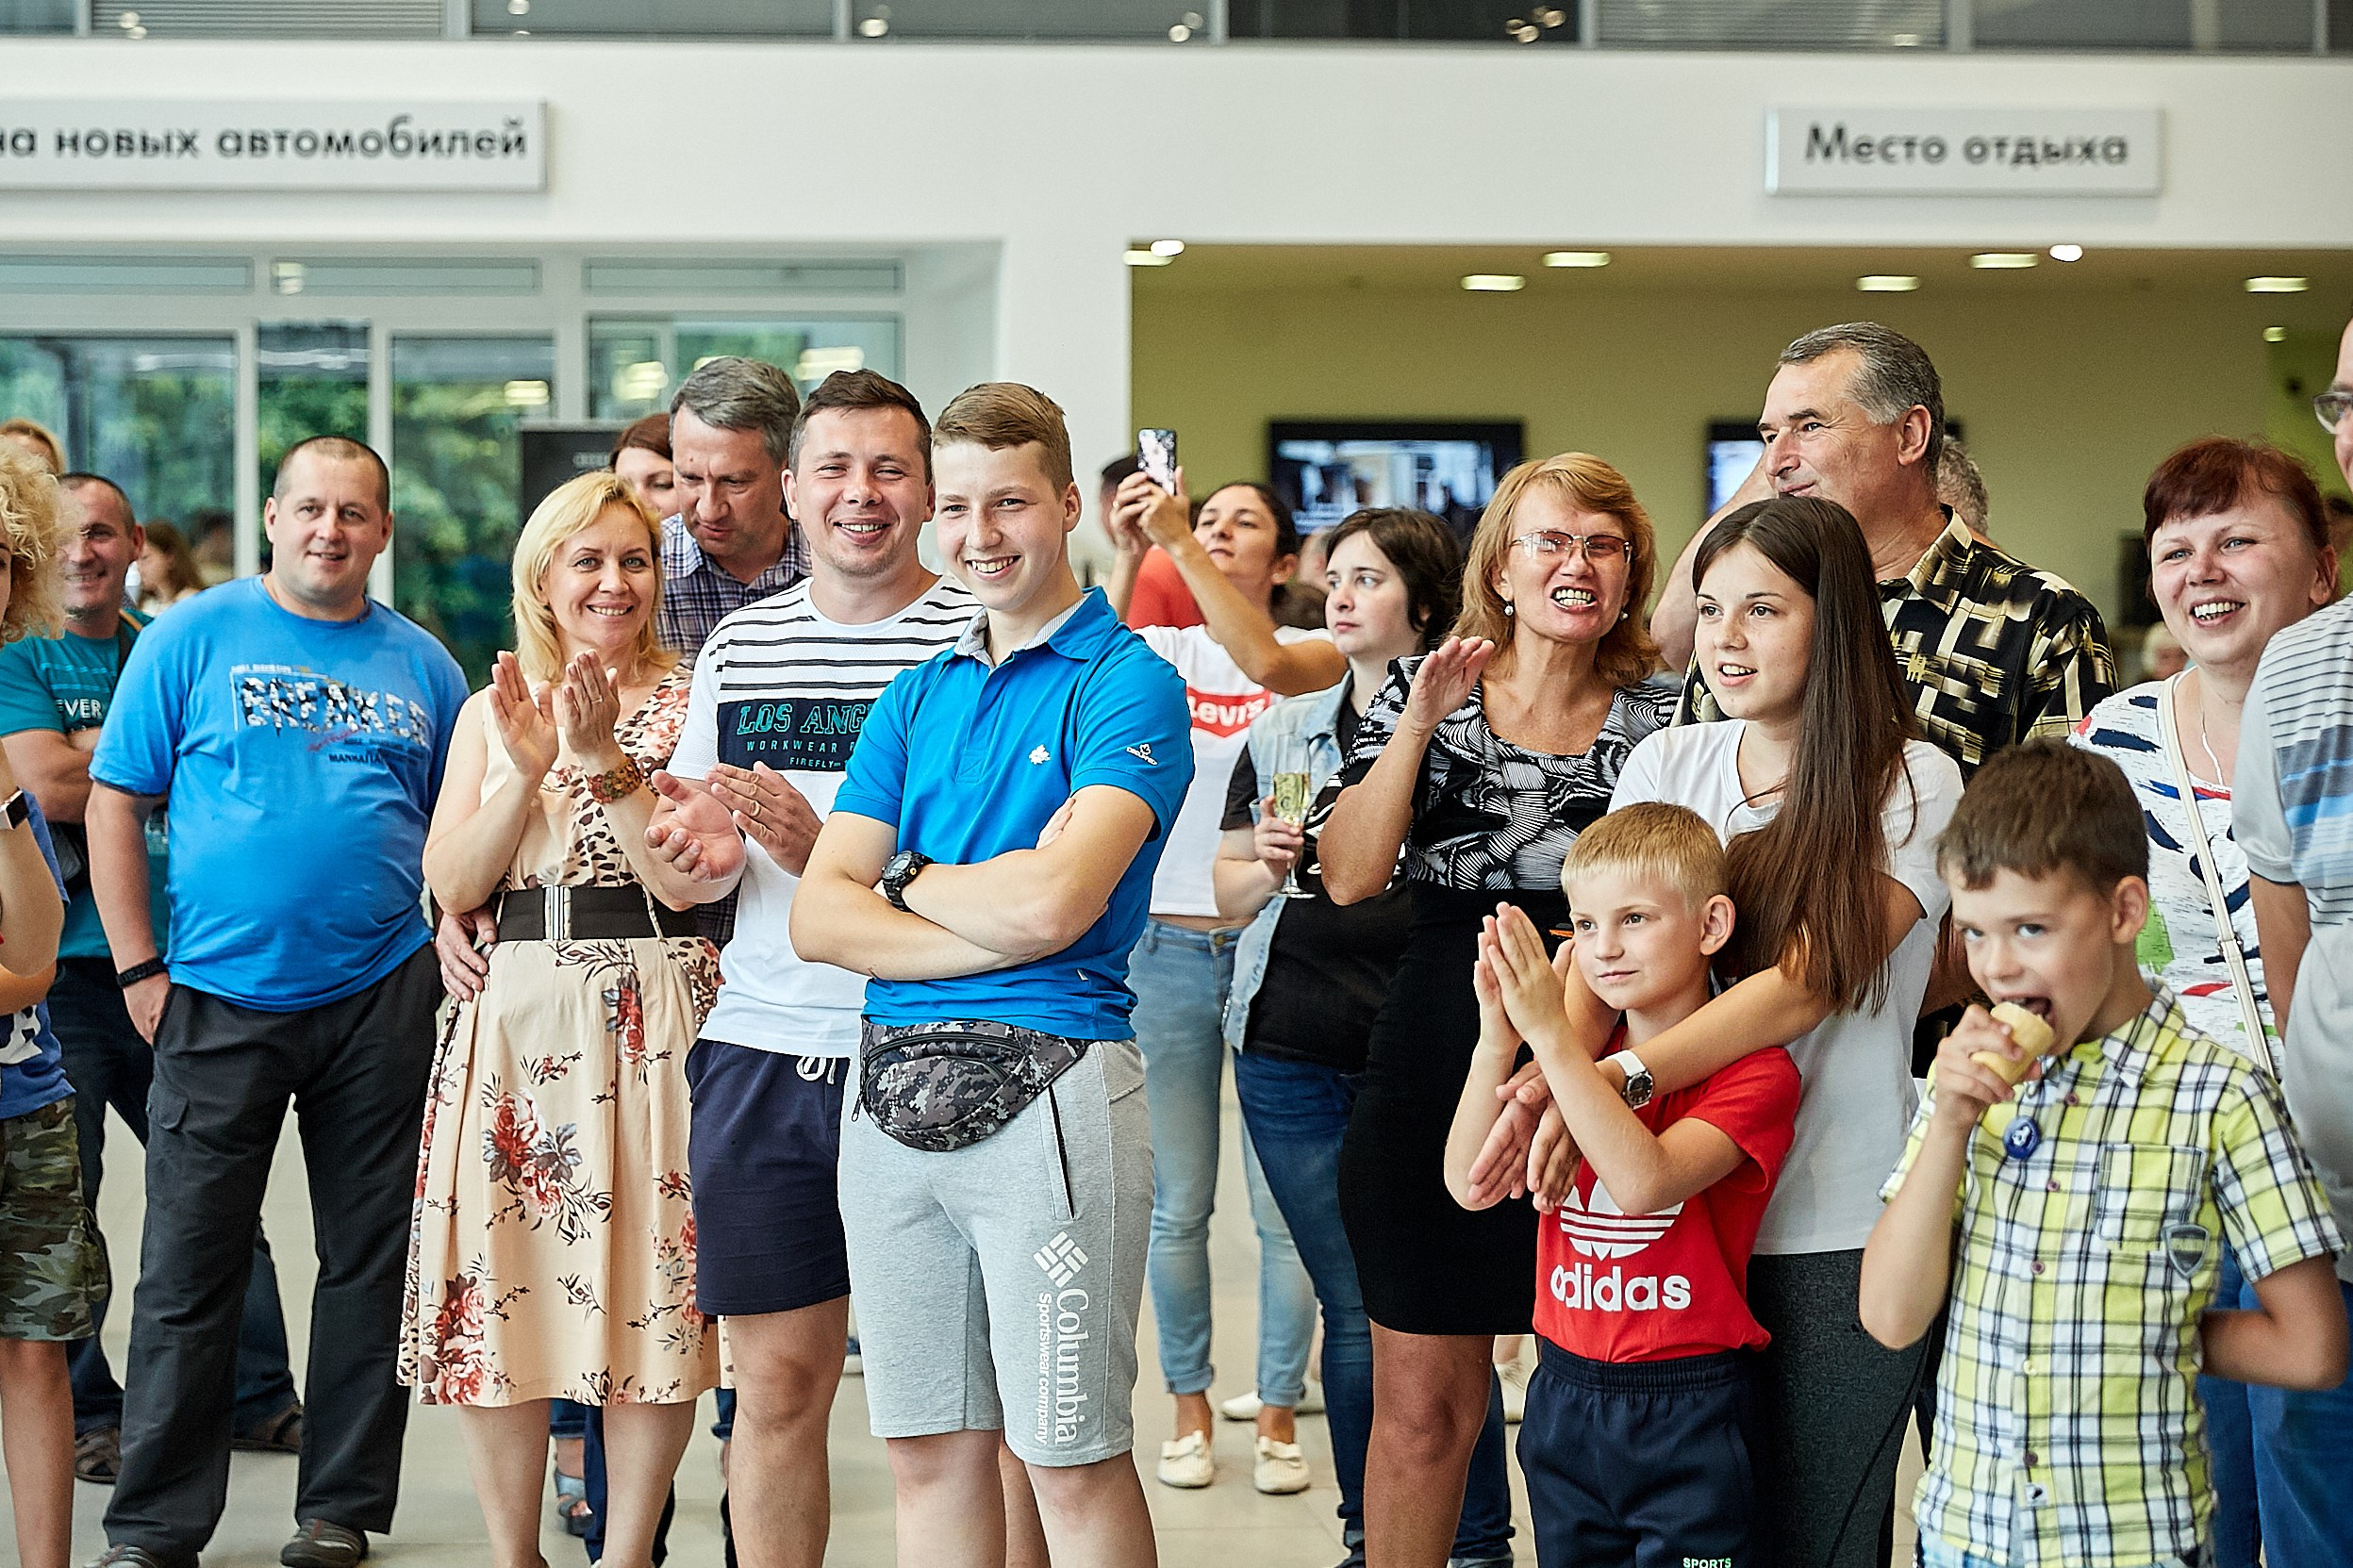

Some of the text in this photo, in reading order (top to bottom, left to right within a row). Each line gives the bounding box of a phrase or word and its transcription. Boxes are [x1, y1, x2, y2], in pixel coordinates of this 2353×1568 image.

[55, 129, 201, 158] новых
[218, 113, 527, 159] автомобилей
[1805, 123, 2128, 168] Место отдыха
[737, 703, 873, 735] LOS ANG
[747, 739, 838, 753] WORKWEAR
[789, 756, 835, 768] FIREFLY
[1549, 1262, 1692, 1312] adidas
[1035, 1292, 1052, 1445] Sportswear company
[1054, 1288, 1089, 1444] Columbia
[1682, 1556, 1732, 1568] SPORTS
